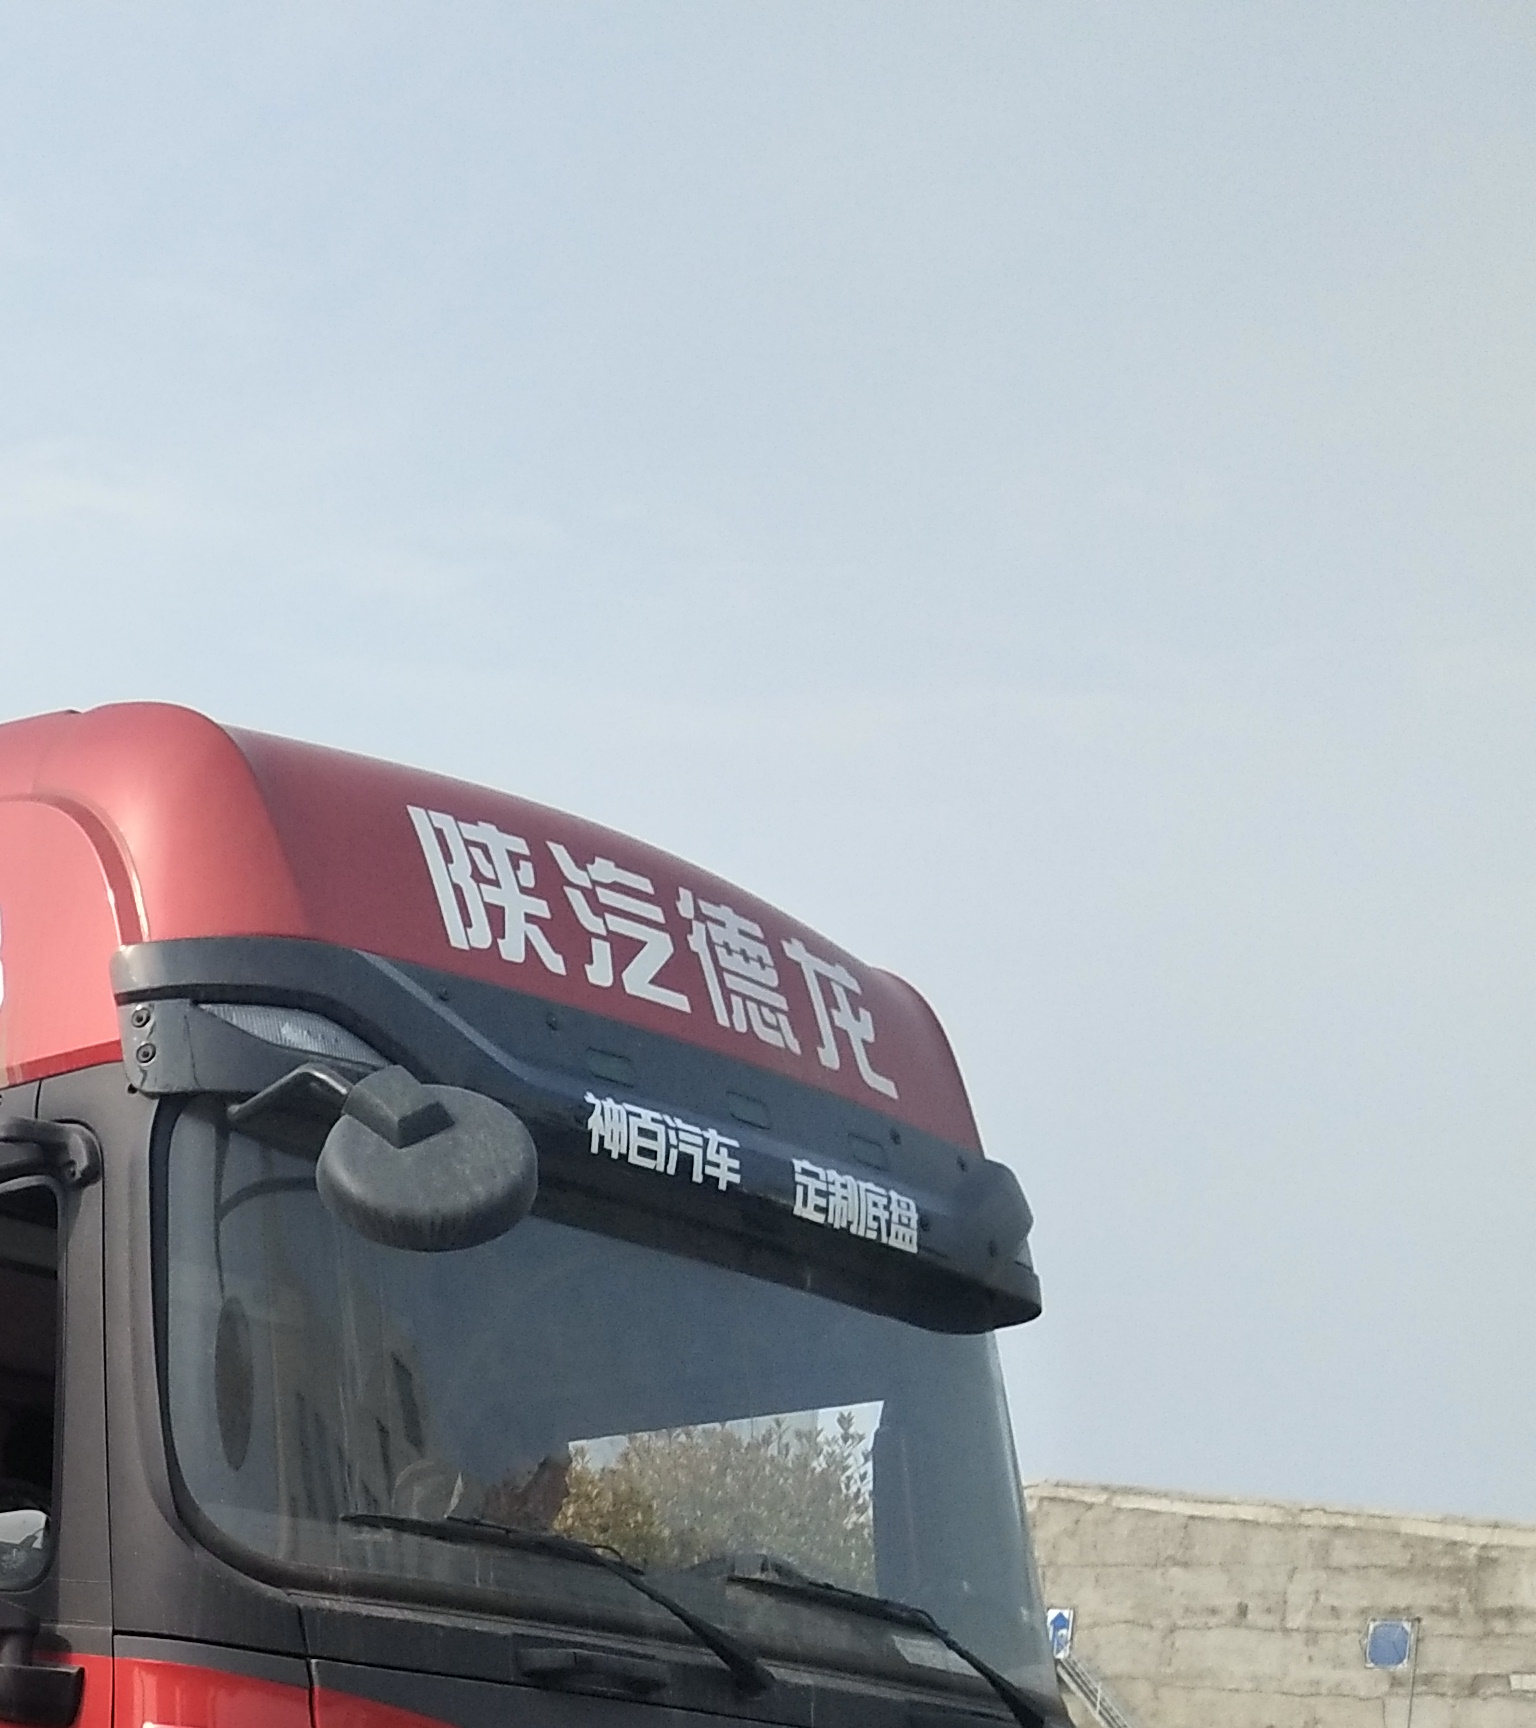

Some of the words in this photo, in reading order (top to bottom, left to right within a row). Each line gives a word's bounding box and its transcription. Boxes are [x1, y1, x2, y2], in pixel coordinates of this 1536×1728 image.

[407, 804, 899, 1099] 陕汽德龙
[584, 1091, 741, 1191] 神百汽车
[792, 1158, 918, 1254] 定制底盘
